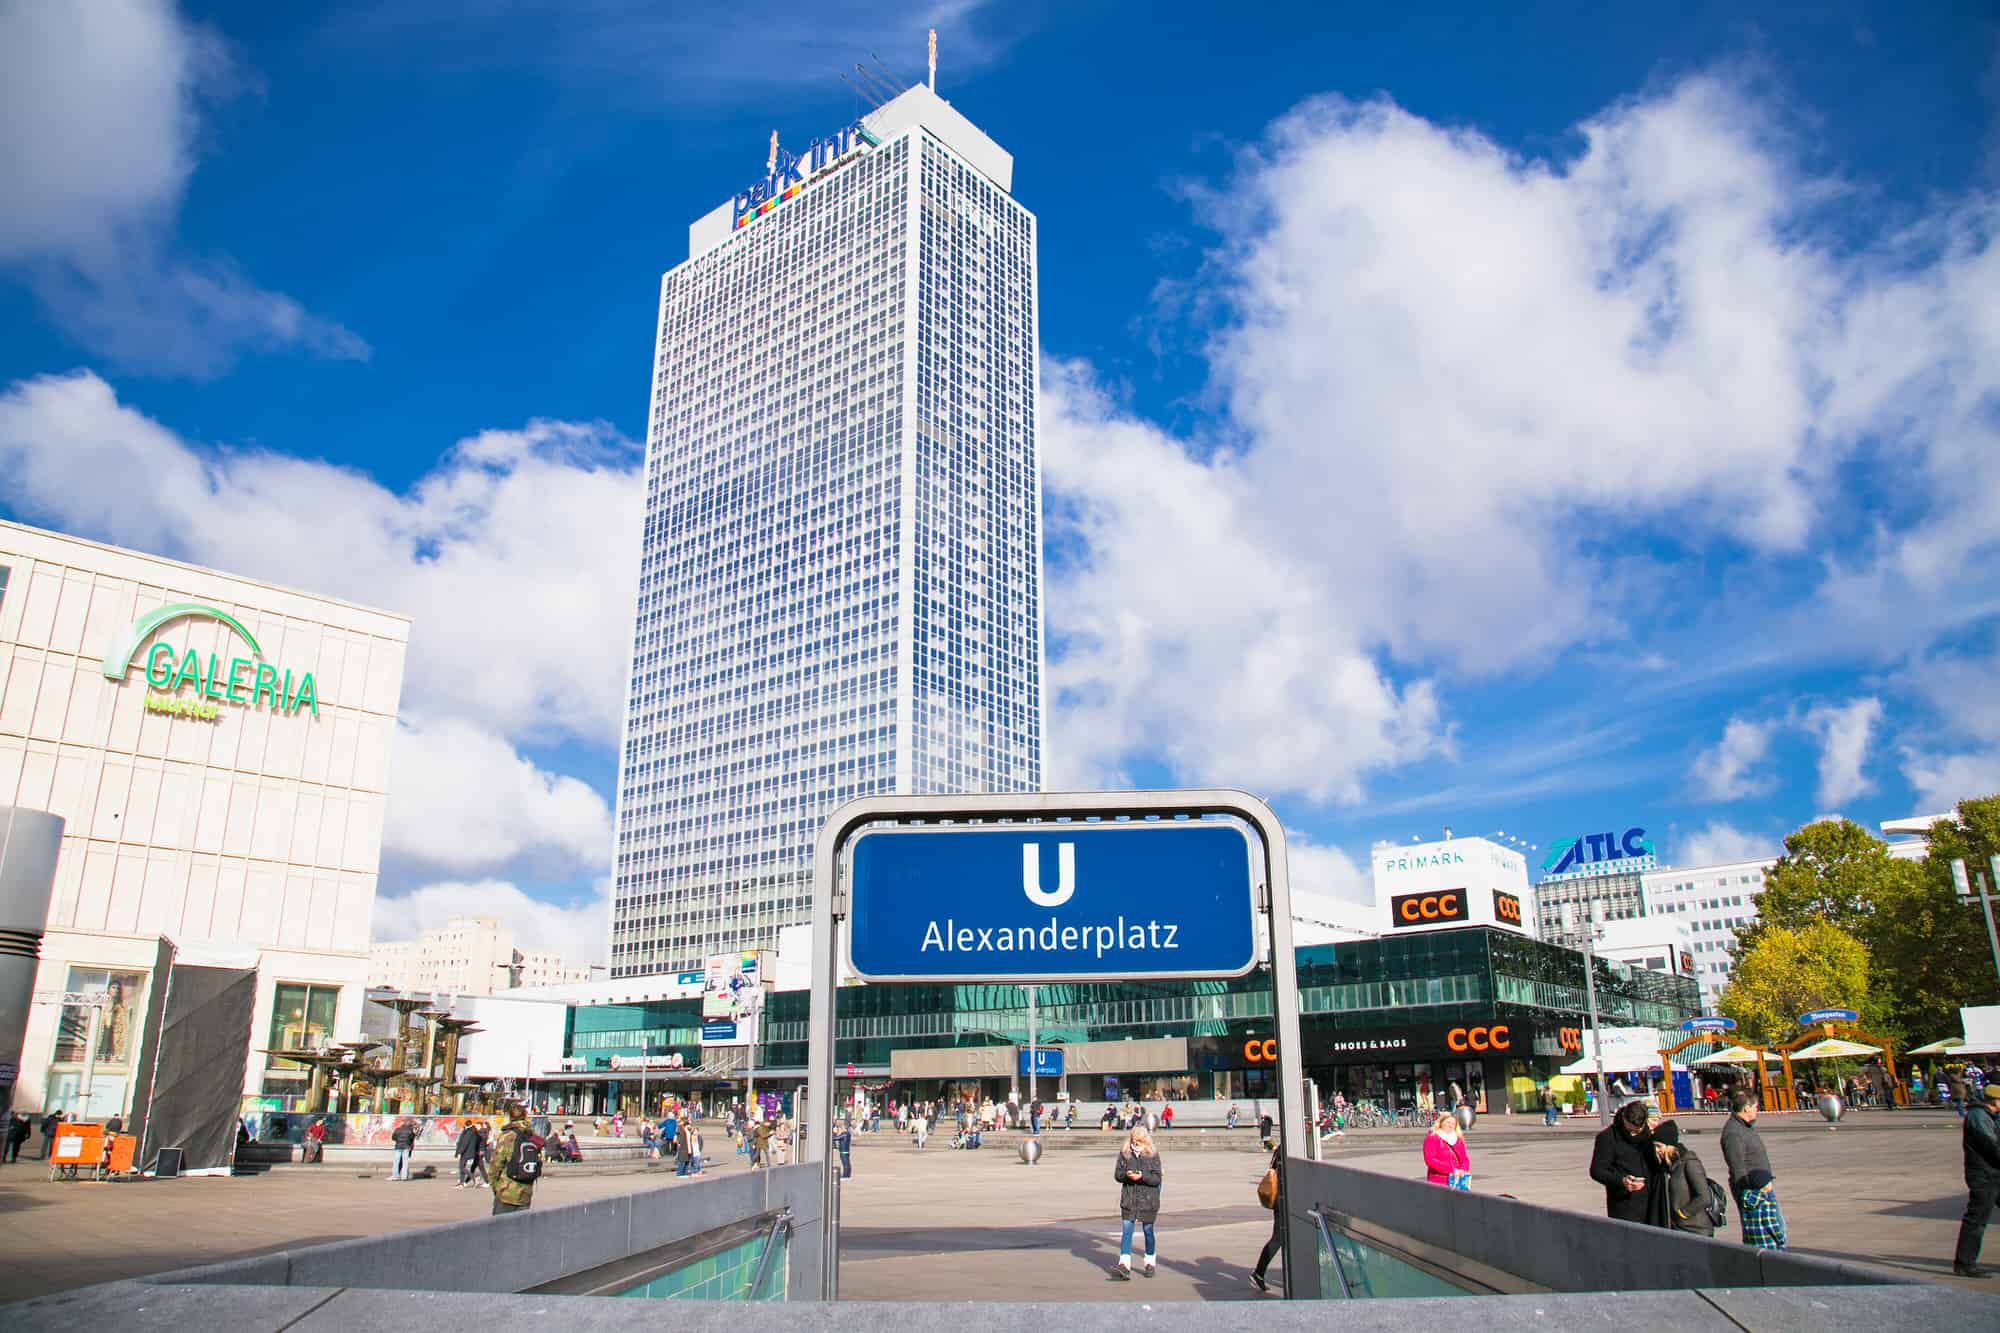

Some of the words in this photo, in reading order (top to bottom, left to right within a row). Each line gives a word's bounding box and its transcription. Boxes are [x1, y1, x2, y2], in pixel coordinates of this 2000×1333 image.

[732, 149, 802, 232] park
[145, 641, 318, 717] GALERIA
[1022, 842, 1075, 908] U
[1401, 894, 1457, 921] CCC
[1498, 895, 1521, 921] CCC
[921, 916, 1179, 958] Alexanderplatz
[1244, 1039, 1277, 1062] CC
[1334, 1041, 1367, 1051] SHOES
[1380, 1039, 1407, 1049] BAGS
[1447, 1024, 1510, 1052] CCC
[1560, 1026, 1581, 1050] CCC
[1038, 1052, 1046, 1065] U
